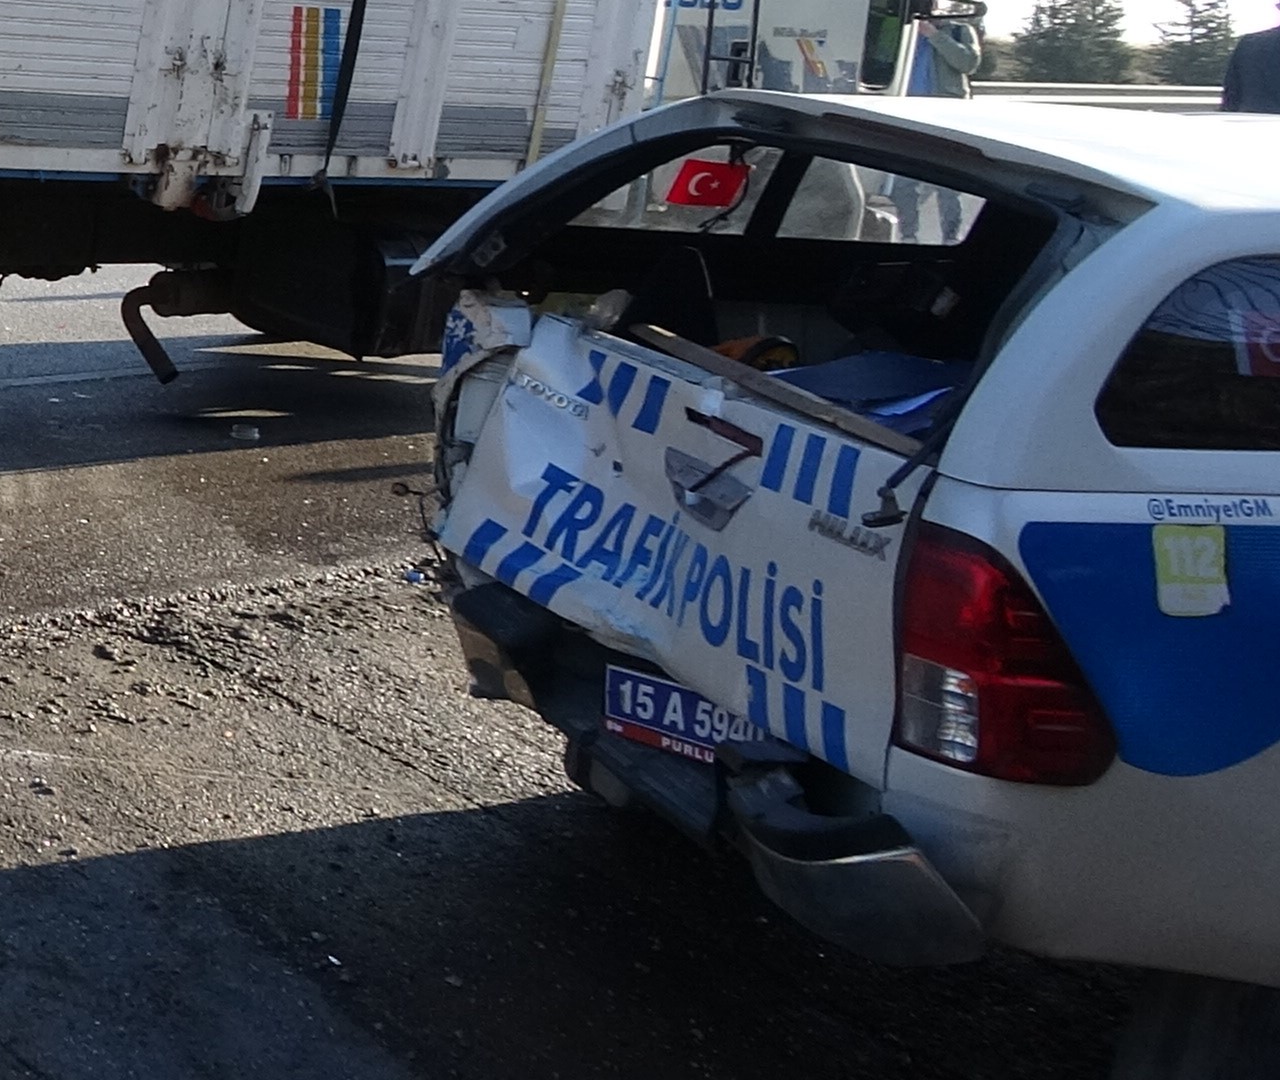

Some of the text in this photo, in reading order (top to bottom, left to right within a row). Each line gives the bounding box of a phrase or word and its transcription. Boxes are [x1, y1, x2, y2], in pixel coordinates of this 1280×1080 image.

[520, 374, 589, 421] TOYOTA
[807, 509, 892, 562] HILUX
[1147, 498, 1273, 523] @EmniyetGM
[1164, 534, 1218, 577] 112
[679, 542, 825, 693] POLİSİ
[619, 679, 655, 721] 15
[662, 691, 686, 732] A
